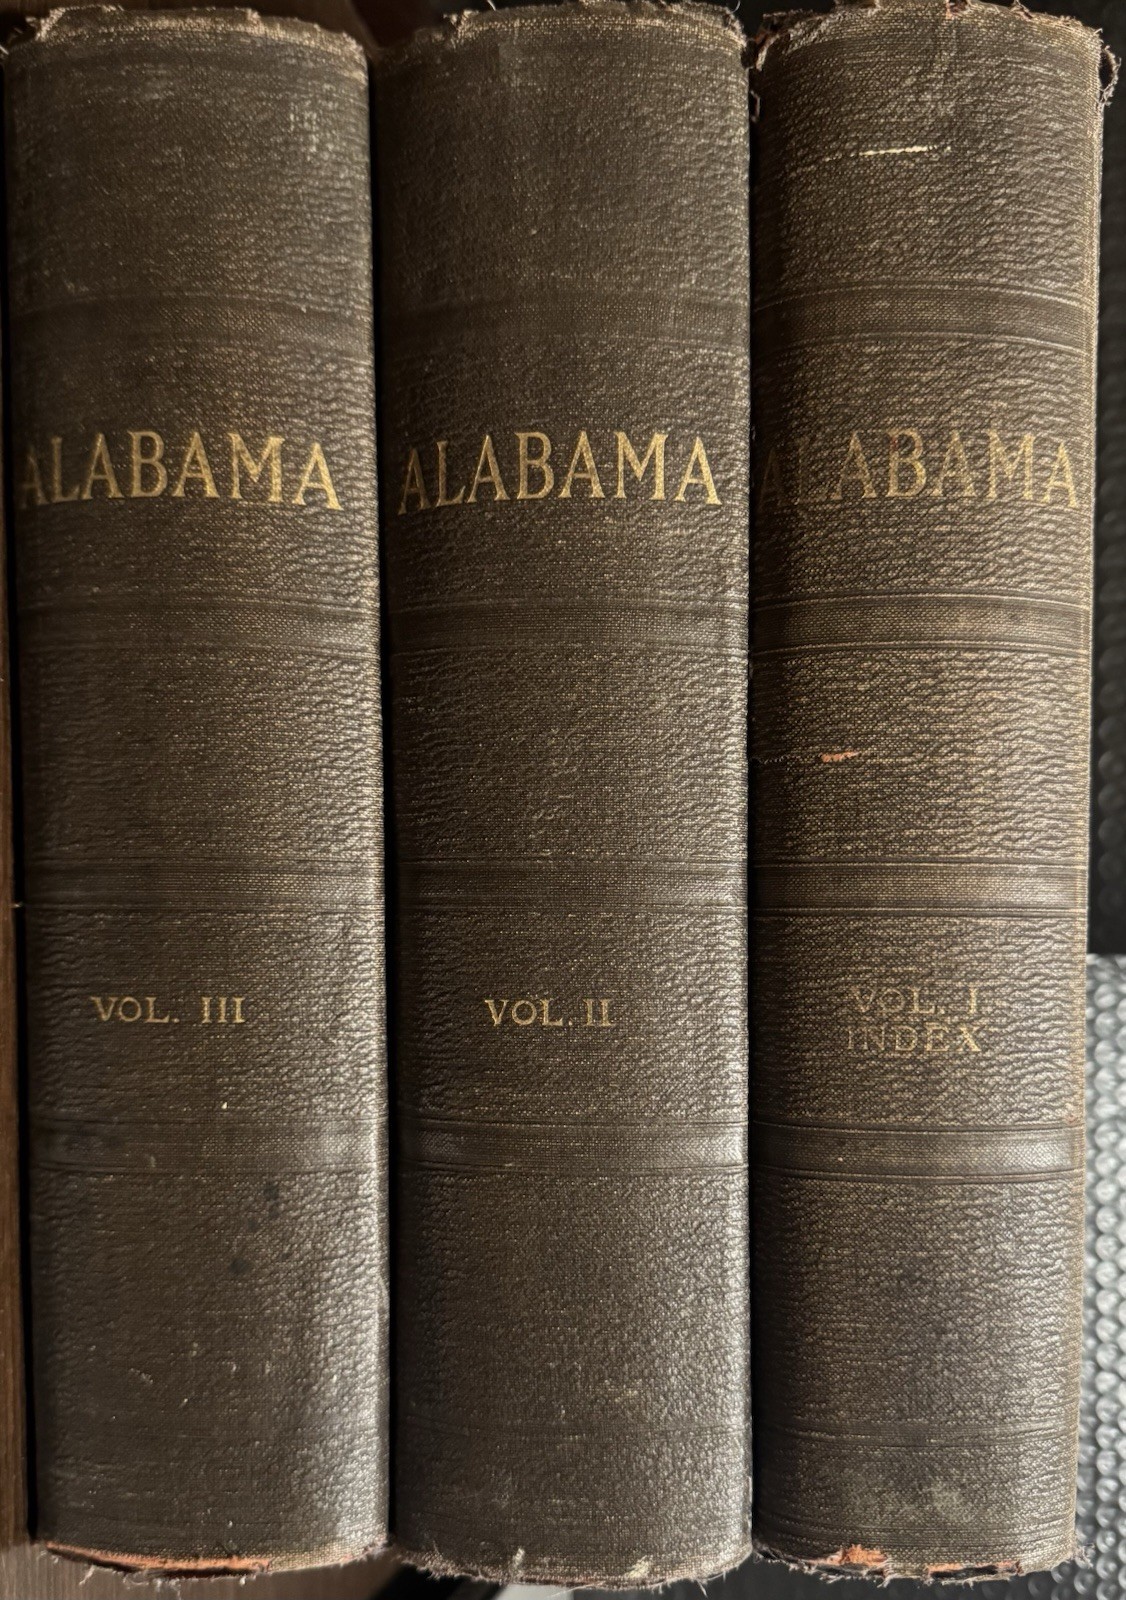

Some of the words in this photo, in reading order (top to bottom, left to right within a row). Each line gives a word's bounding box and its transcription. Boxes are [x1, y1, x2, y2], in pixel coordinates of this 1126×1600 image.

[22, 430, 344, 511] ALABAMA
[397, 430, 723, 515] ALABAMA
[90, 996, 180, 1024] VOL.
[201, 996, 246, 1024] III
[484, 998, 573, 1027] VOL.
[584, 998, 615, 1027] II
[850, 986, 945, 1015] VOL.
[966, 986, 979, 1015] I
[846, 1022, 982, 1051] INDEX
